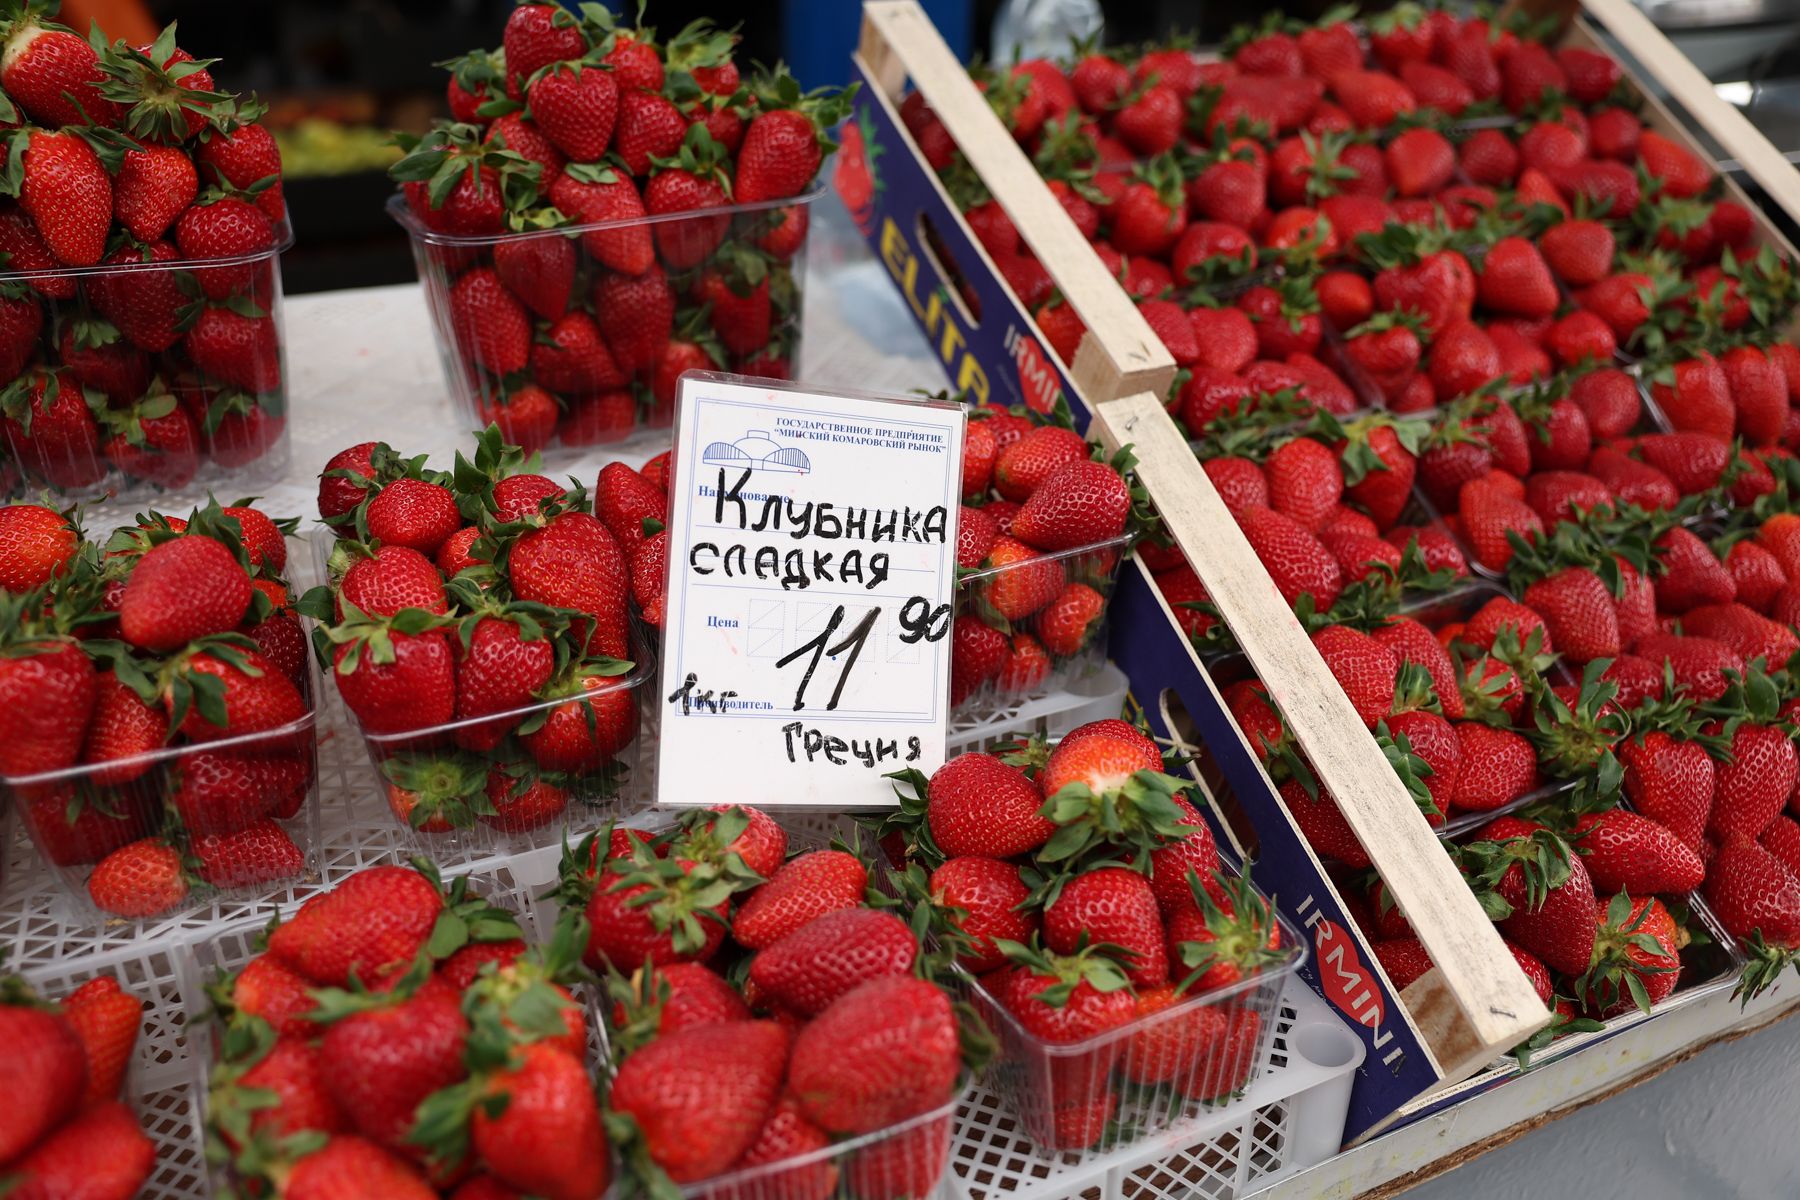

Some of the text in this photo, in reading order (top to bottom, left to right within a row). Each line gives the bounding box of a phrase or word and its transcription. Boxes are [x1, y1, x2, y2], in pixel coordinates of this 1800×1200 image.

[776, 417, 944, 444] ГОСУДАРСТВЕННОЕ ПРЕДПРИЯТИЕ
[832, 434, 906, 450] КОМАРОВСКИЙ
[707, 615, 739, 629] Цена
[775, 596, 952, 711] 11 90
[1295, 893, 1404, 1067] IRMINI
